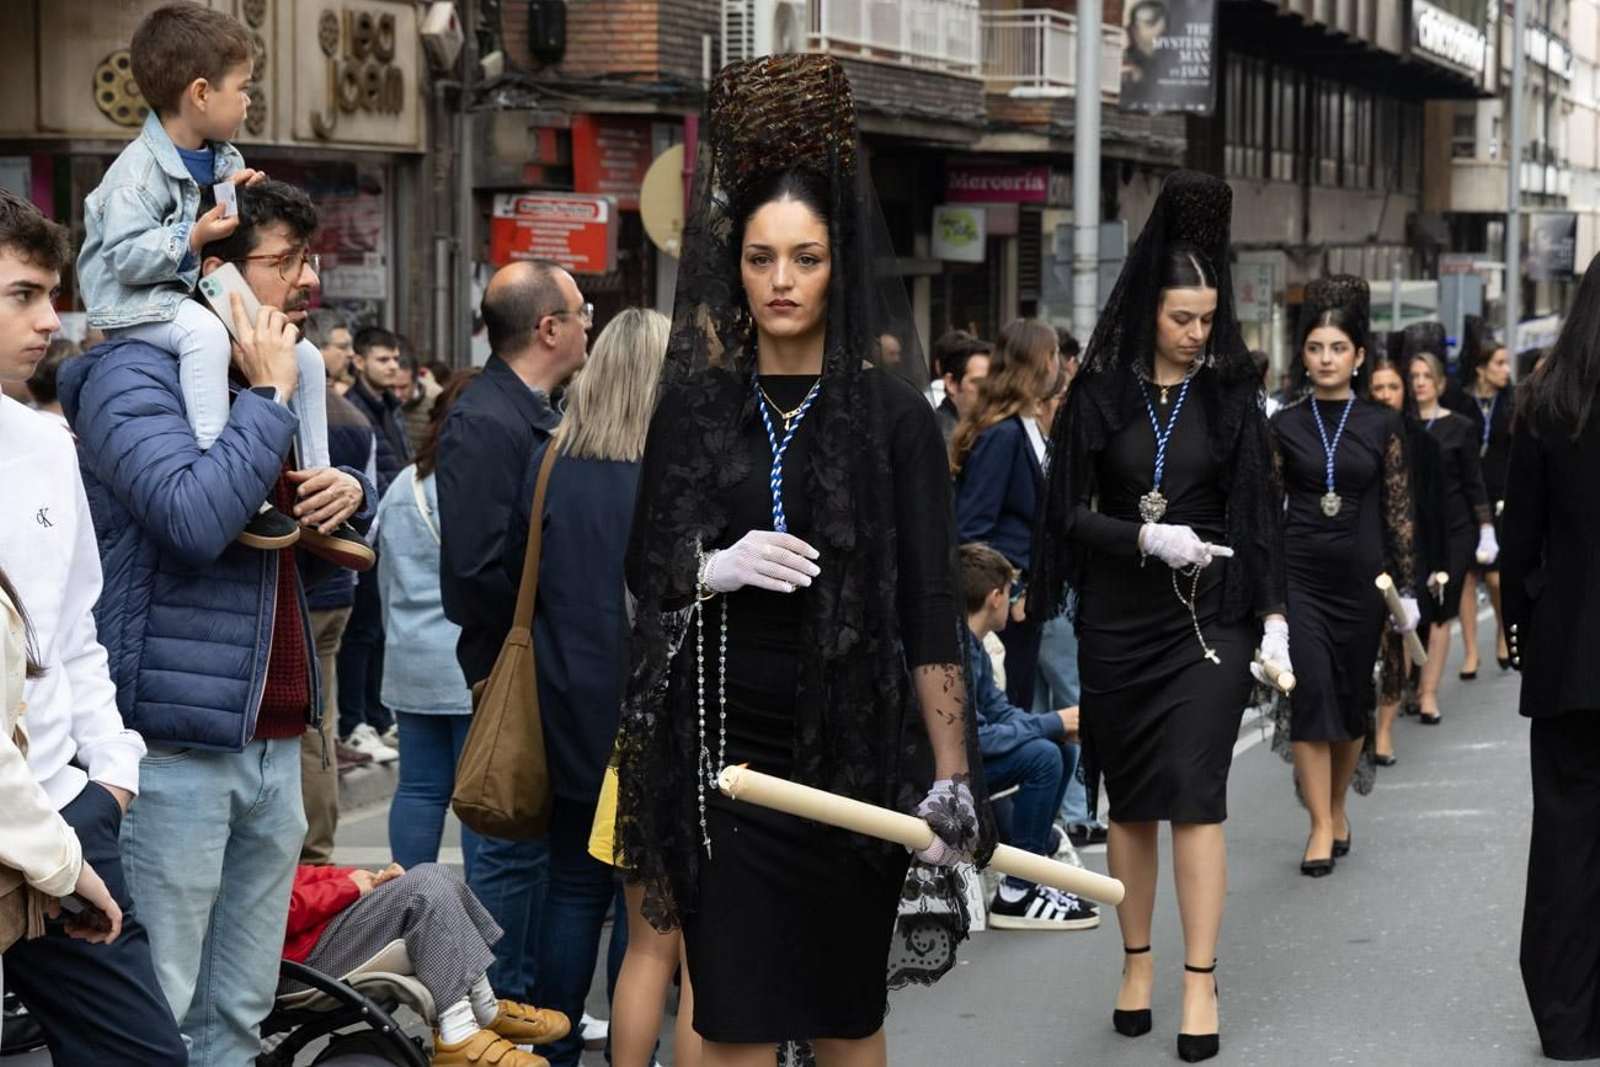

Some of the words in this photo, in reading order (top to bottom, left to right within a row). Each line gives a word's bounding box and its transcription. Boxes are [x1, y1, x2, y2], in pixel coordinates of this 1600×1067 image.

[1187, 23, 1210, 36] THE
[1152, 37, 1209, 49] MYSTERY
[1180, 50, 1210, 62] MAN
[949, 172, 1044, 190] Mercería
